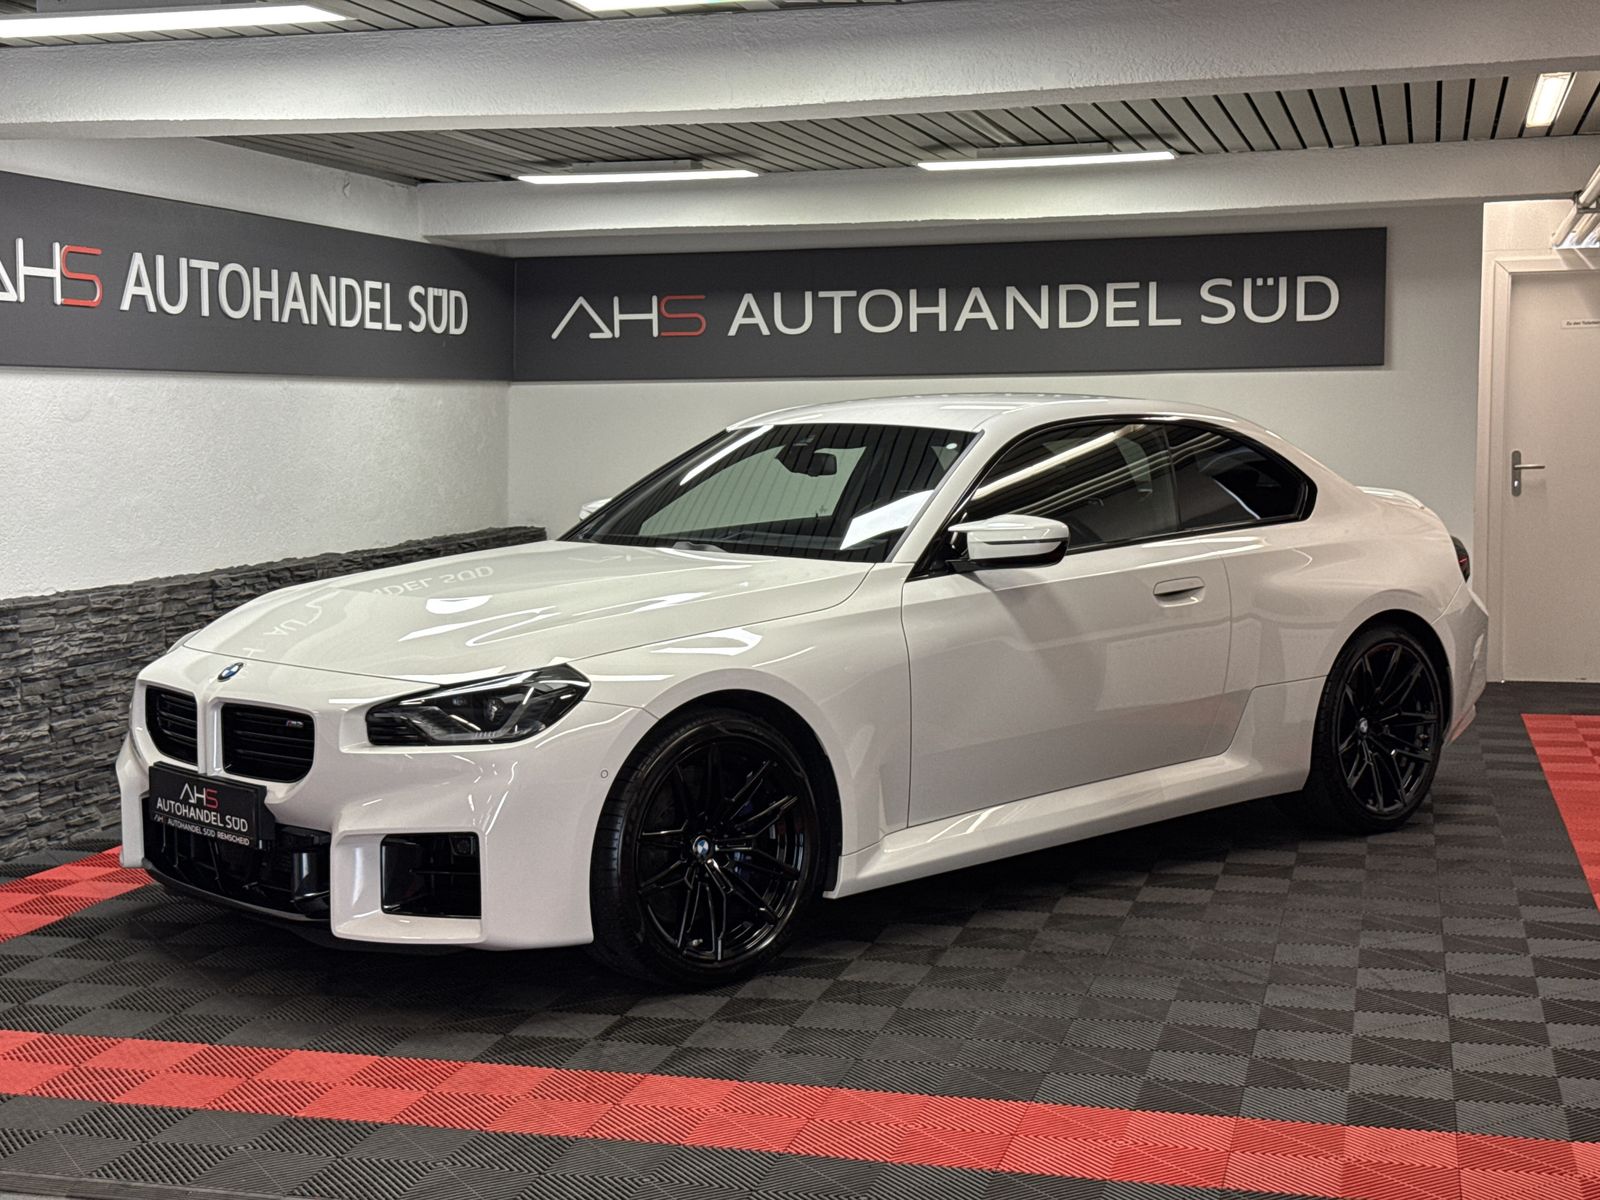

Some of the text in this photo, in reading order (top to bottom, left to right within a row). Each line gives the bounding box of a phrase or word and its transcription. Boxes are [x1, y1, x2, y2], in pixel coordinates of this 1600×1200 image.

[119, 252, 403, 332] AUTOHANDEL
[408, 285, 470, 336] SÜD
[550, 274, 1340, 340] AHS AUTOHANDEL SÜD
[179, 783, 218, 809] AHS
[156, 797, 224, 826] AUTOHANDEL
[168, 819, 202, 834] AUTOHANDEL
[217, 831, 250, 846] REMSCHEID
